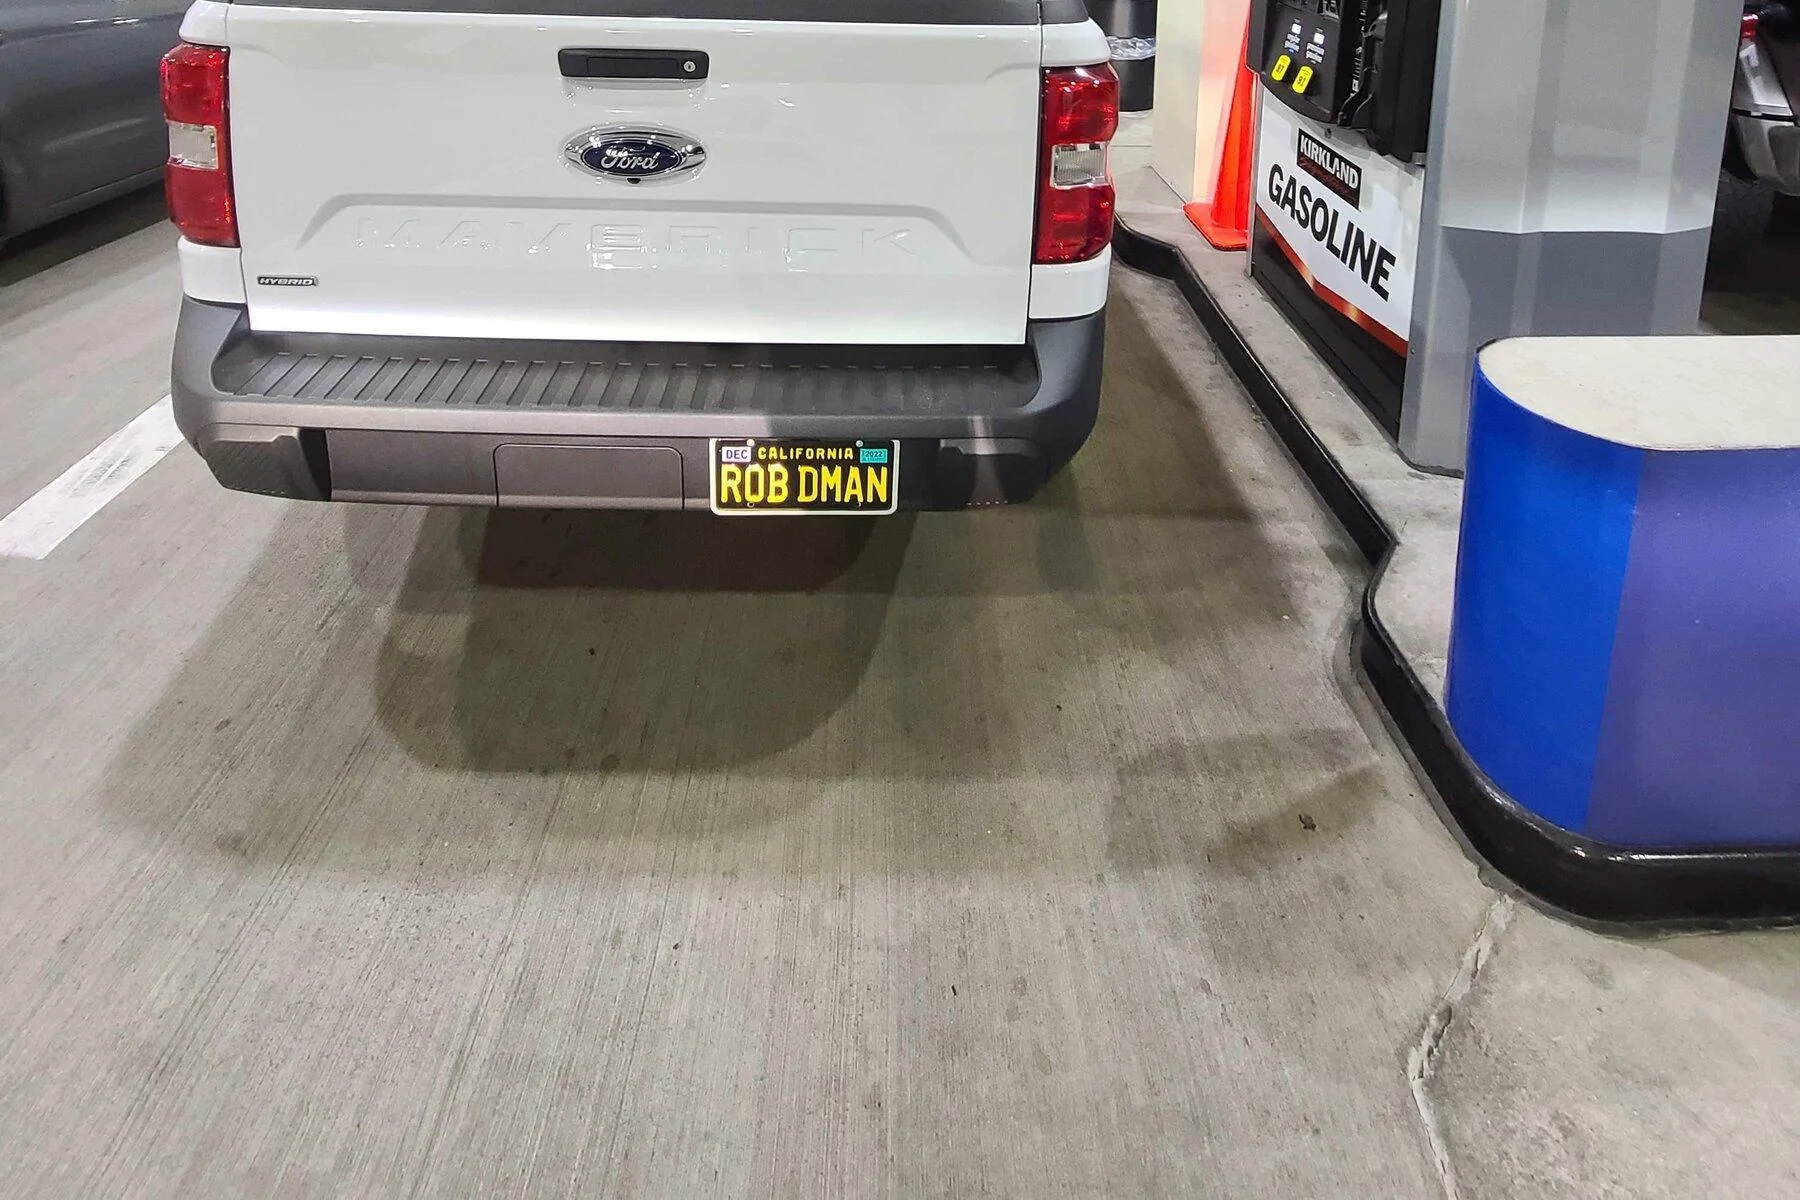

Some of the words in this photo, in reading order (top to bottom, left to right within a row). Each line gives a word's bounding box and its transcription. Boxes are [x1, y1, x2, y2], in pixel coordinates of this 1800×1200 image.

[601, 145, 662, 170] Ford
[1300, 134, 1359, 189] KIRKLAND
[354, 216, 915, 258] MAVERICK
[1268, 163, 1397, 303] GASOLINE
[260, 277, 313, 286] HYBRID
[726, 449, 748, 460] DEC
[757, 446, 854, 460] CALIFORNIA
[864, 450, 883, 458] 2022
[720, 462, 789, 504] ROB
[797, 463, 888, 504] DMAN
